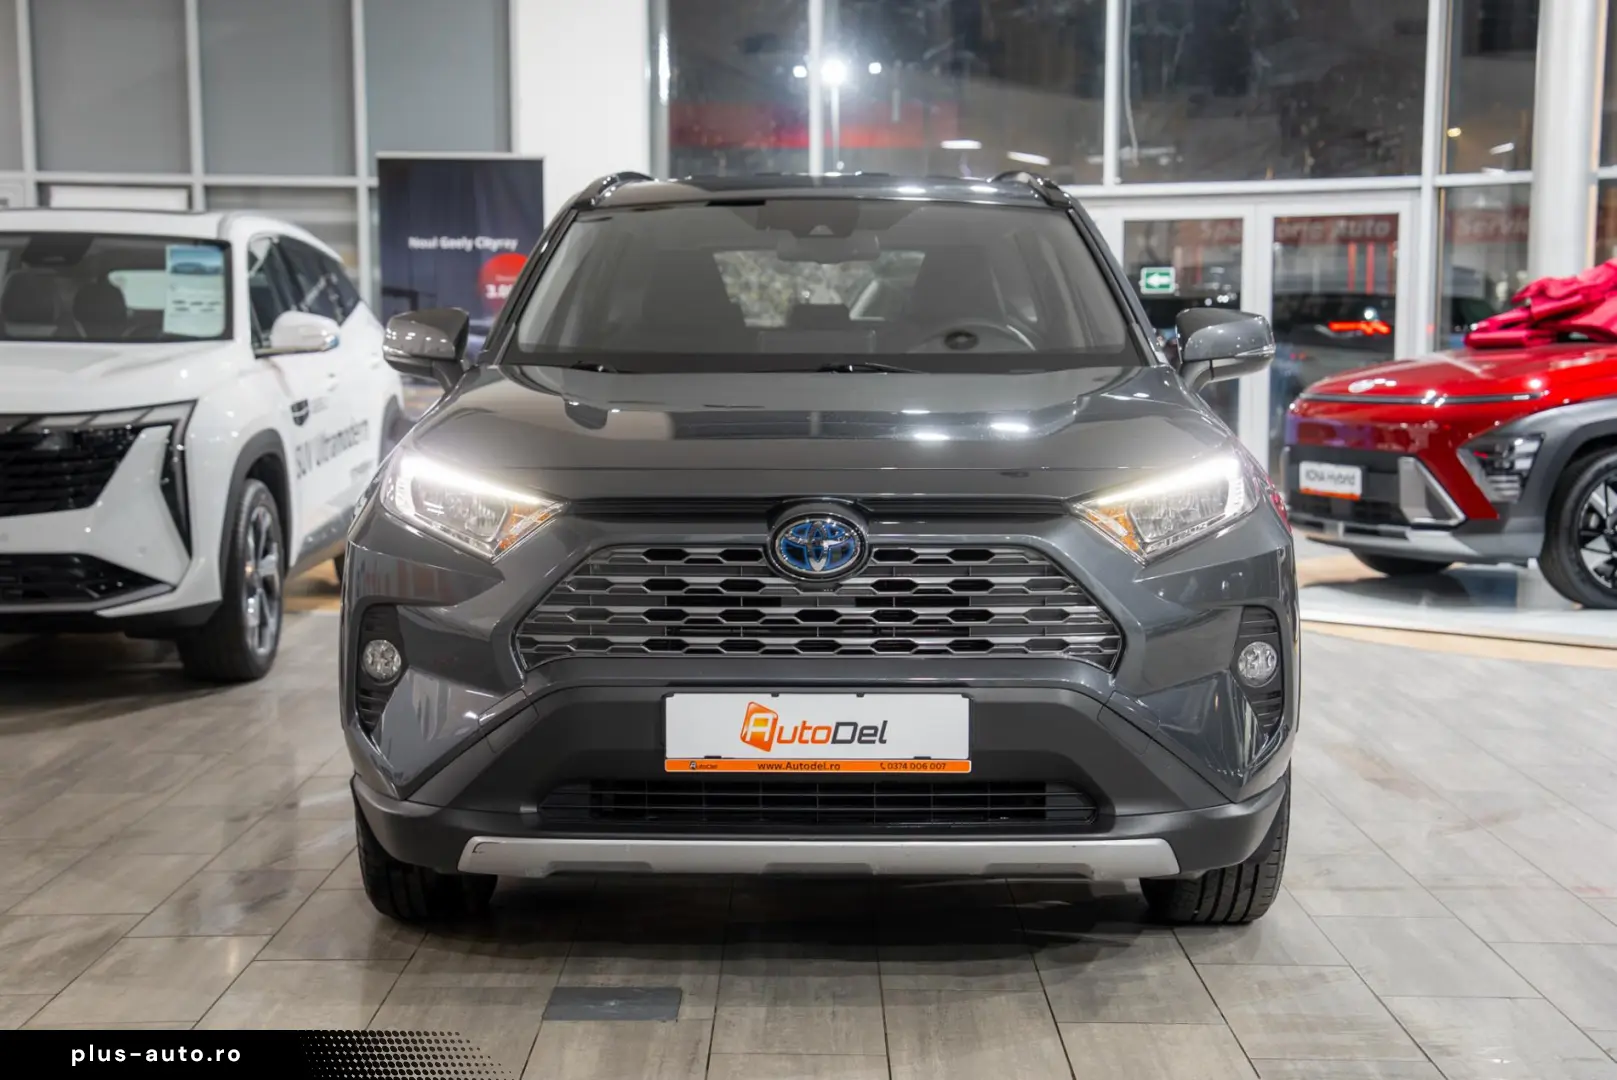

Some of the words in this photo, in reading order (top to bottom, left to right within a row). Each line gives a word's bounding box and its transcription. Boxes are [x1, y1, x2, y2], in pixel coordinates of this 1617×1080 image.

[408, 236, 438, 250] Noul
[440, 236, 473, 252] Geely
[475, 236, 519, 252] Cityray
[742, 708, 888, 746] AutoDel
[757, 761, 841, 771] www.Autodel.ro
[887, 762, 907, 770] 0374
[909, 762, 928, 770] 006
[929, 762, 946, 770] 007
